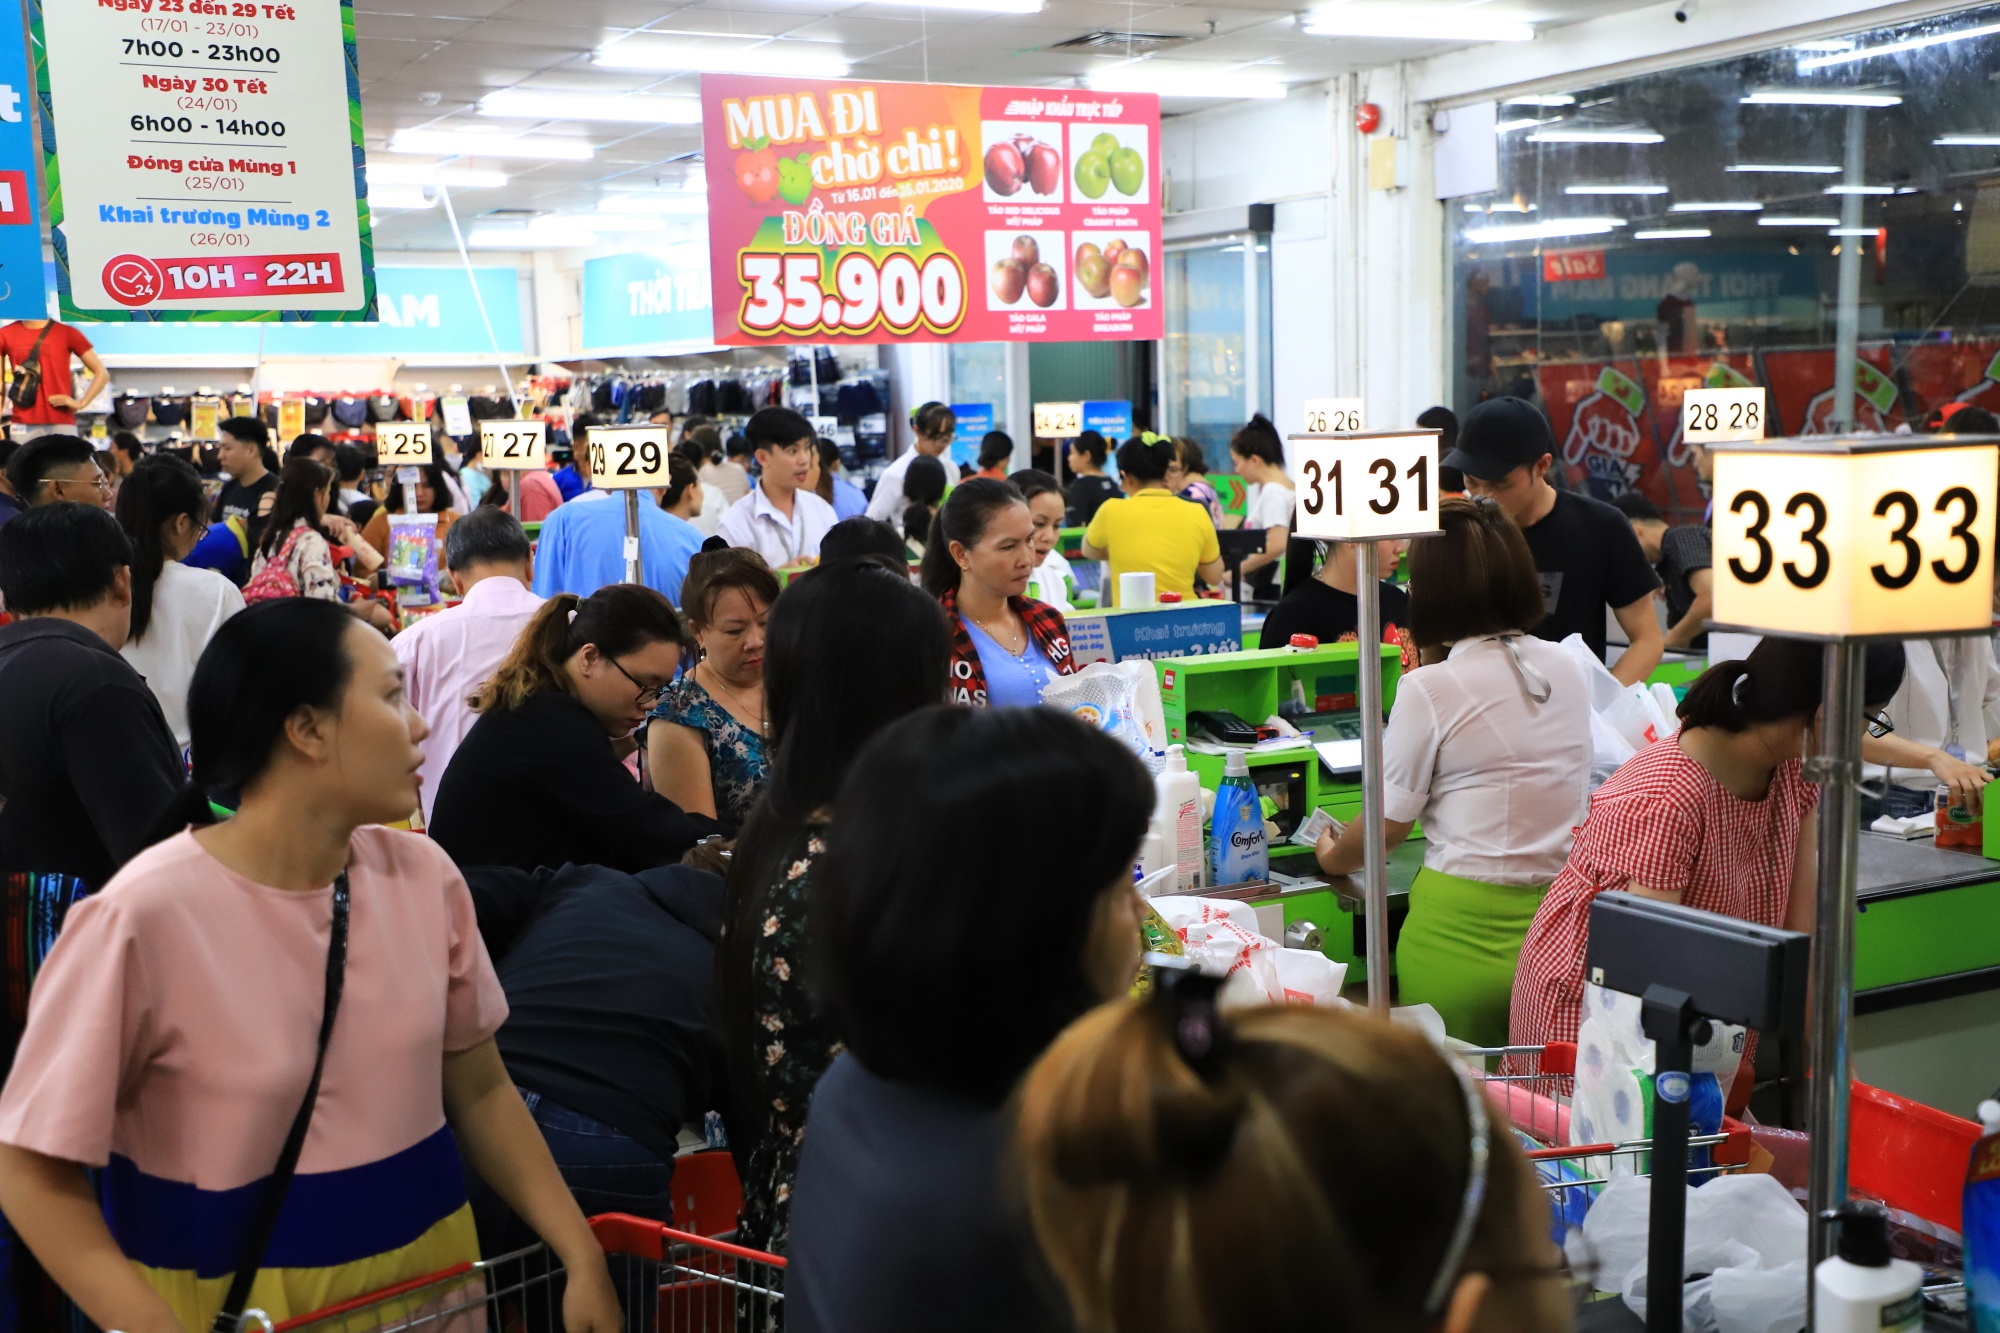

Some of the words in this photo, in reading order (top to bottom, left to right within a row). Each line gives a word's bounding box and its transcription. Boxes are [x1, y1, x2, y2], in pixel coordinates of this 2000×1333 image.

[159, 0, 184, 12] 23
[189, 0, 227, 16] đến
[232, 3, 257, 18] 29
[262, 3, 296, 20] Tết
[141, 18, 189, 33] (17/01
[206, 22, 259, 39] 23/01)
[122, 38, 184, 58] 7h00
[208, 44, 280, 63] 23h00
[142, 74, 197, 93] Ngày
[202, 77, 229, 92] 30
[234, 77, 268, 95] Tết
[177, 96, 238, 112] (24/01)
[130, 115, 193, 133] 6h00
[215, 118, 286, 137] 14h00
[726, 96, 825, 145] MUA
[831, 90, 879, 135] ĐI
[127, 155, 183, 173] Đóng
[188, 156, 224, 172] cửa
[229, 158, 283, 176] Mùng
[287, 160, 297, 175] 1
[811, 139, 881, 185] chờ
[185, 176, 245, 192] (25/01)
[831, 190, 846, 204] Từ
[846, 187, 877, 202] 16.01
[878, 185, 898, 200] đến
[99, 204, 154, 223] Khai
[160, 207, 241, 229] trương
[247, 208, 310, 231] Mùng
[315, 209, 331, 227] 2
[782, 197, 866, 245] ĐỒNG
[870, 205, 921, 246] GIÁ
[190, 232, 250, 247] (26/01)
[167, 264, 236, 290] 10H
[264, 261, 333, 286] 22H
[135, 283, 154, 296] 24
[742, 252, 963, 328] 35.900
[1055, 412, 1076, 430] 24
[1307, 411, 1327, 432] 26
[1334, 410, 1360, 431] 26
[1689, 403, 1718, 430] 28
[1729, 402, 1759, 430] 28
[394, 432, 426, 455] 25
[503, 432, 538, 457] 27
[591, 442, 606, 475] 29
[615, 441, 662, 475] 29
[1303, 459, 1343, 515] 31
[1368, 455, 1428, 515] 31
[1728, 489, 1830, 590] 33
[1870, 486, 1981, 590] 33
[1134, 624, 1170, 642] Khai
[1173, 622, 1226, 638] trương
[1231, 829, 1265, 850] Comfort
